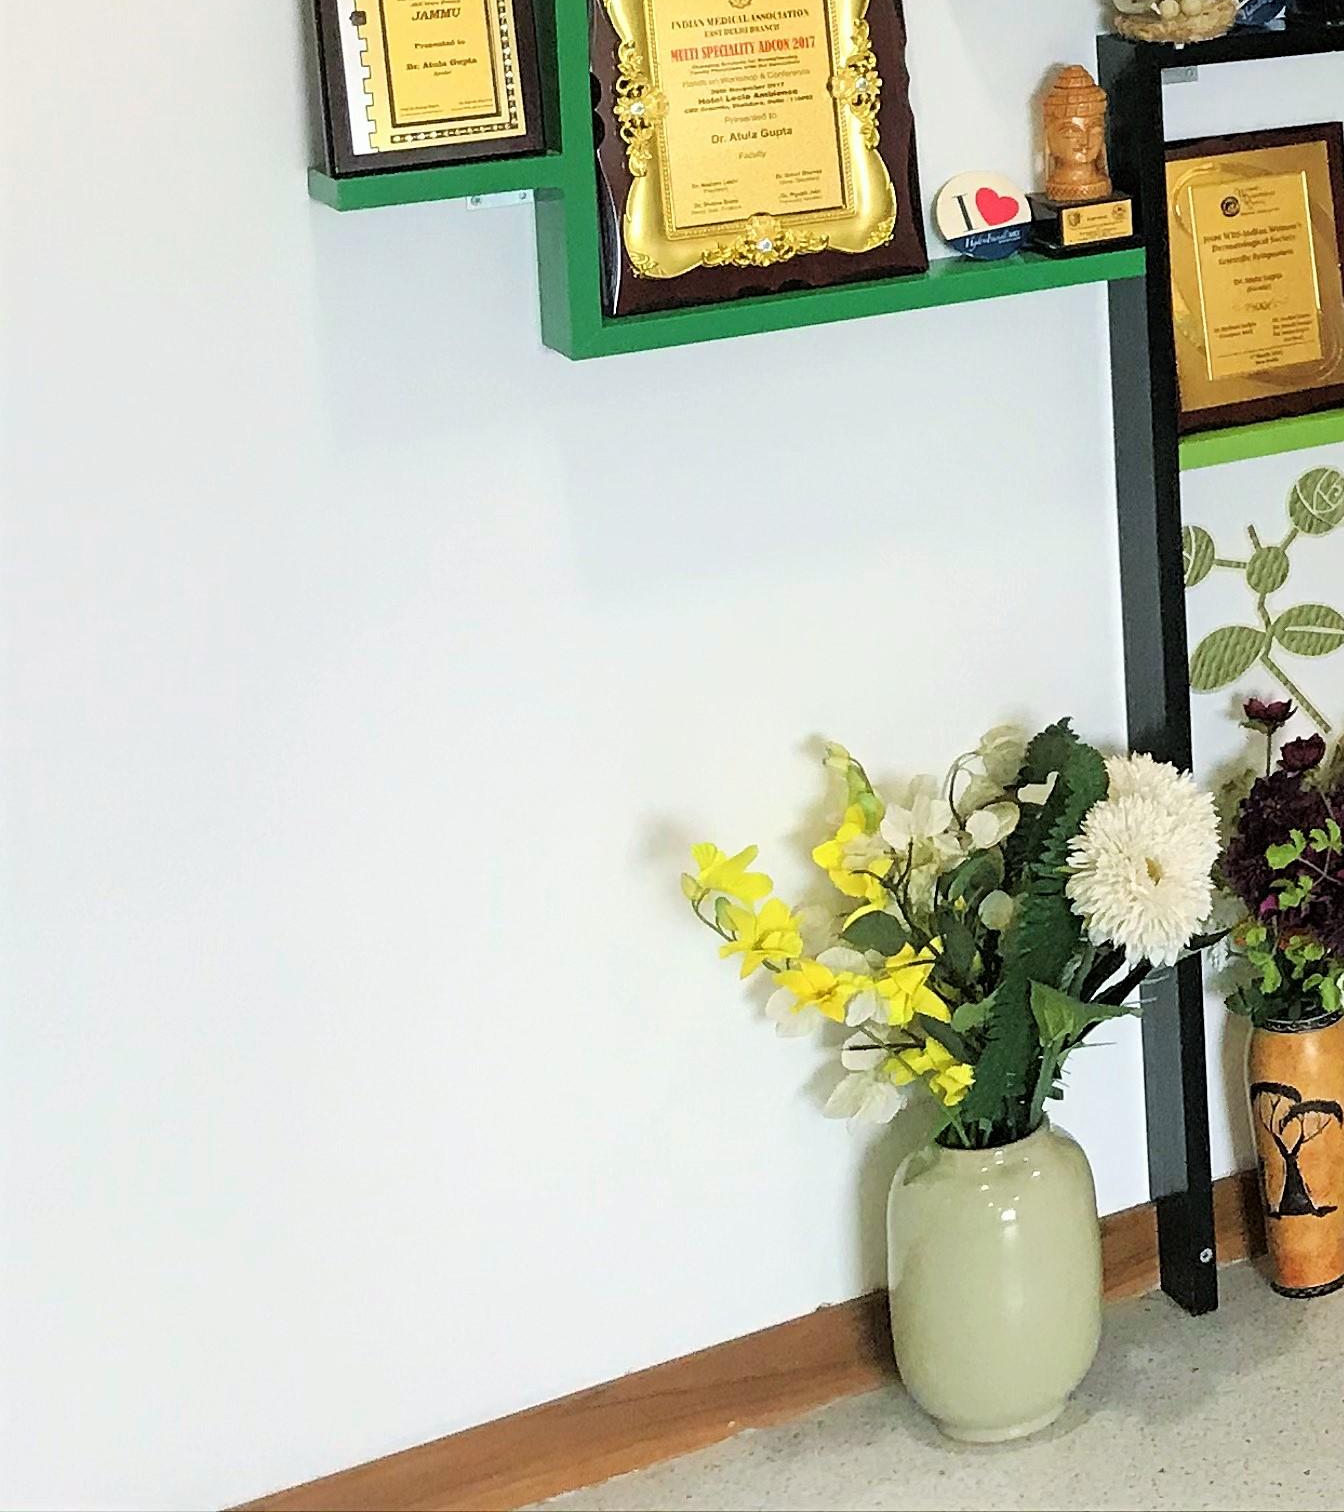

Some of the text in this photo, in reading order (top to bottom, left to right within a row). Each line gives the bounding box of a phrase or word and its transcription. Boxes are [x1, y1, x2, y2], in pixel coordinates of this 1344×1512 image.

[411, 7, 461, 21] JAMMU
[671, 8, 810, 30] INDIAN MEDICAL ASSOCIATION
[671, 35, 816, 63] MULTI SPECIALITY ADCON 2017
[423, 60, 447, 69] Atula
[449, 57, 477, 66] Gupta
[711, 127, 793, 144] Dr. Atula Gupta
[952, 193, 974, 232] I
